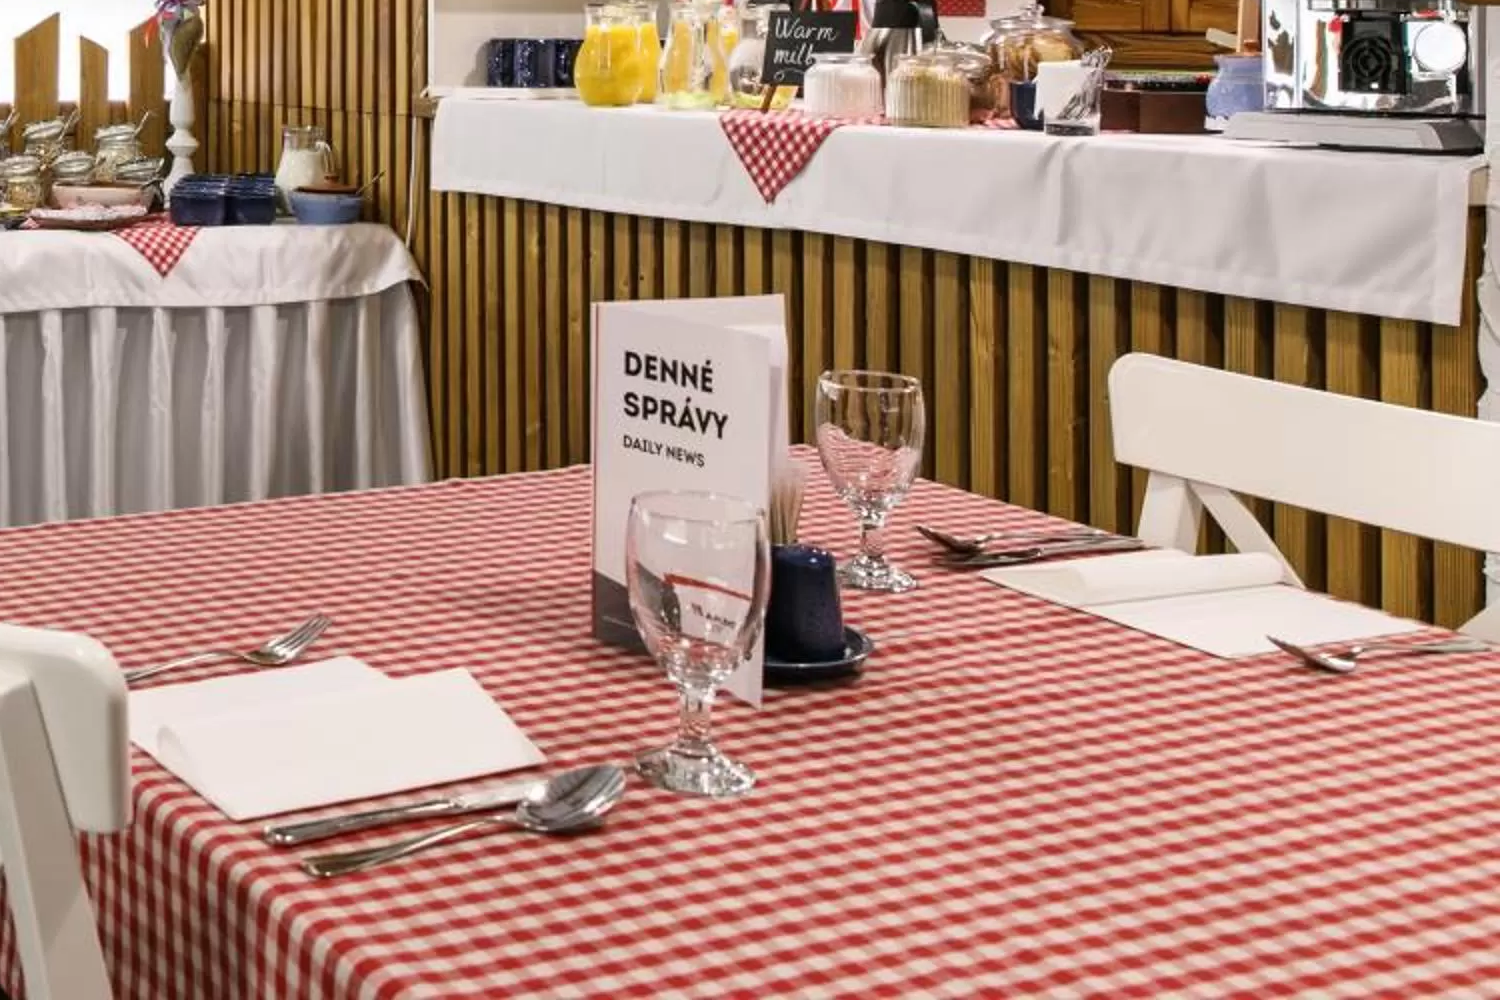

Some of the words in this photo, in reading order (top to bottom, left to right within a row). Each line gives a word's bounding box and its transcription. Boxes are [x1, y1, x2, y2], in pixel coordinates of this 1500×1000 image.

[775, 17, 837, 41] Warm
[625, 351, 713, 393] DENNÉ
[624, 392, 728, 440] SPRÁVY
[623, 434, 663, 456] DAILY
[666, 445, 705, 468] NEWS
